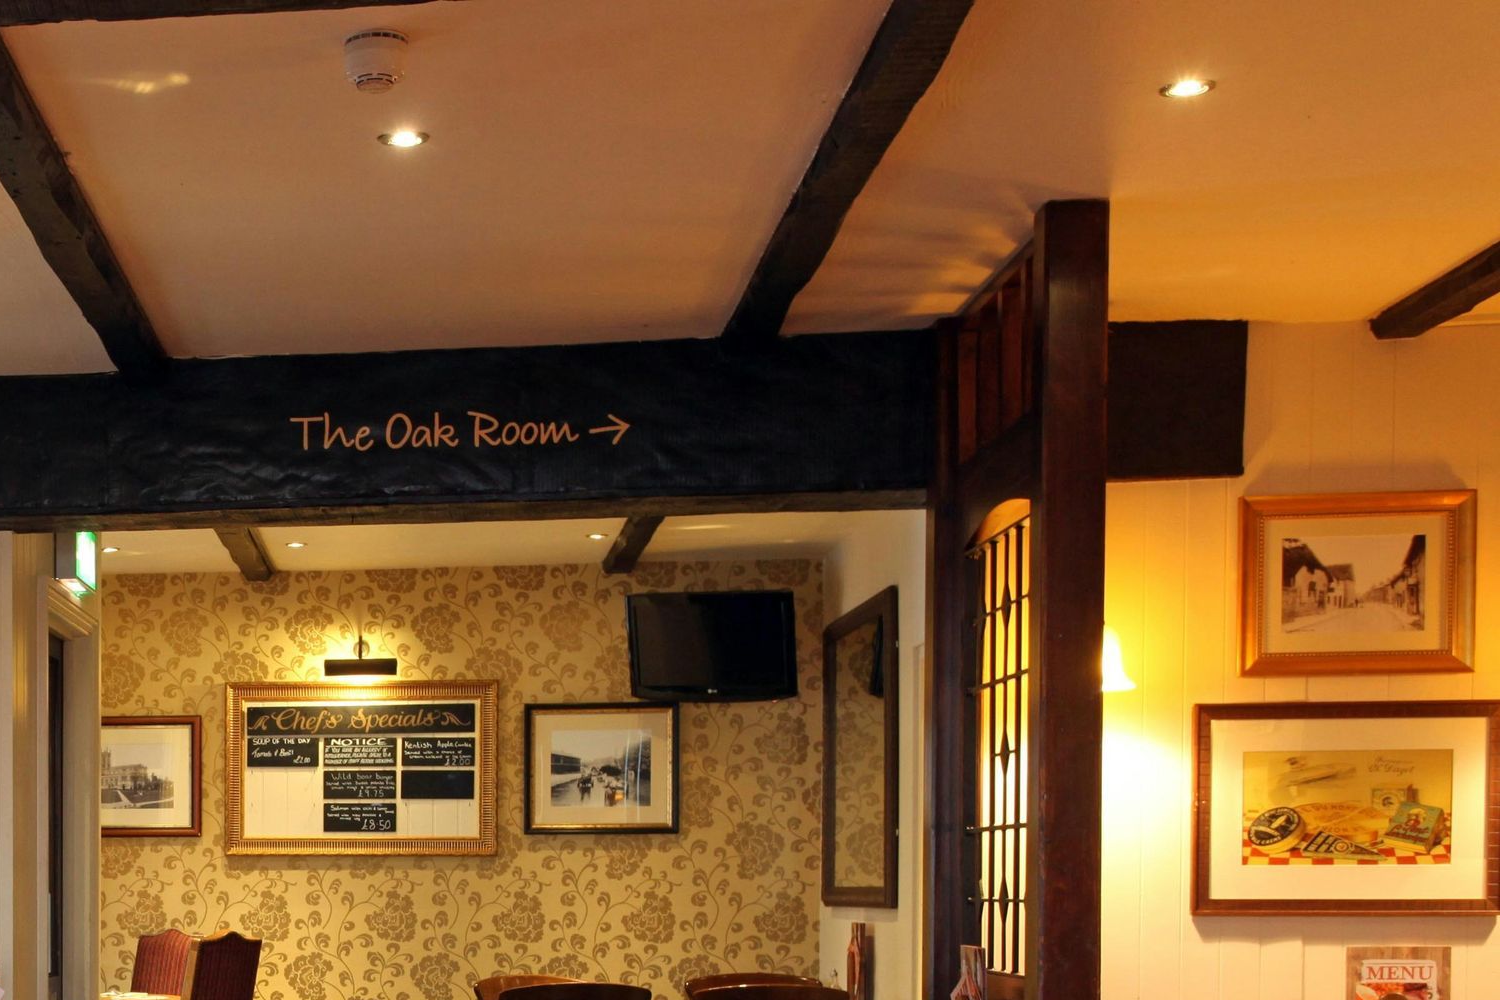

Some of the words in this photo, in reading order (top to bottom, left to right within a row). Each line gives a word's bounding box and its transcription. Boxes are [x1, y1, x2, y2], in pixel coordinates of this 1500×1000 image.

[289, 412, 374, 451] The
[385, 412, 459, 449] Oak
[466, 410, 580, 448] Room
[271, 708, 343, 735] Chef's
[349, 708, 440, 733] Specials
[252, 738, 270, 746] SOUP
[330, 738, 387, 746] NOTICE
[404, 740, 433, 749] Kentish
[330, 772, 352, 780] Wild
[356, 772, 373, 780] boar
[1366, 966, 1434, 980] MENU
